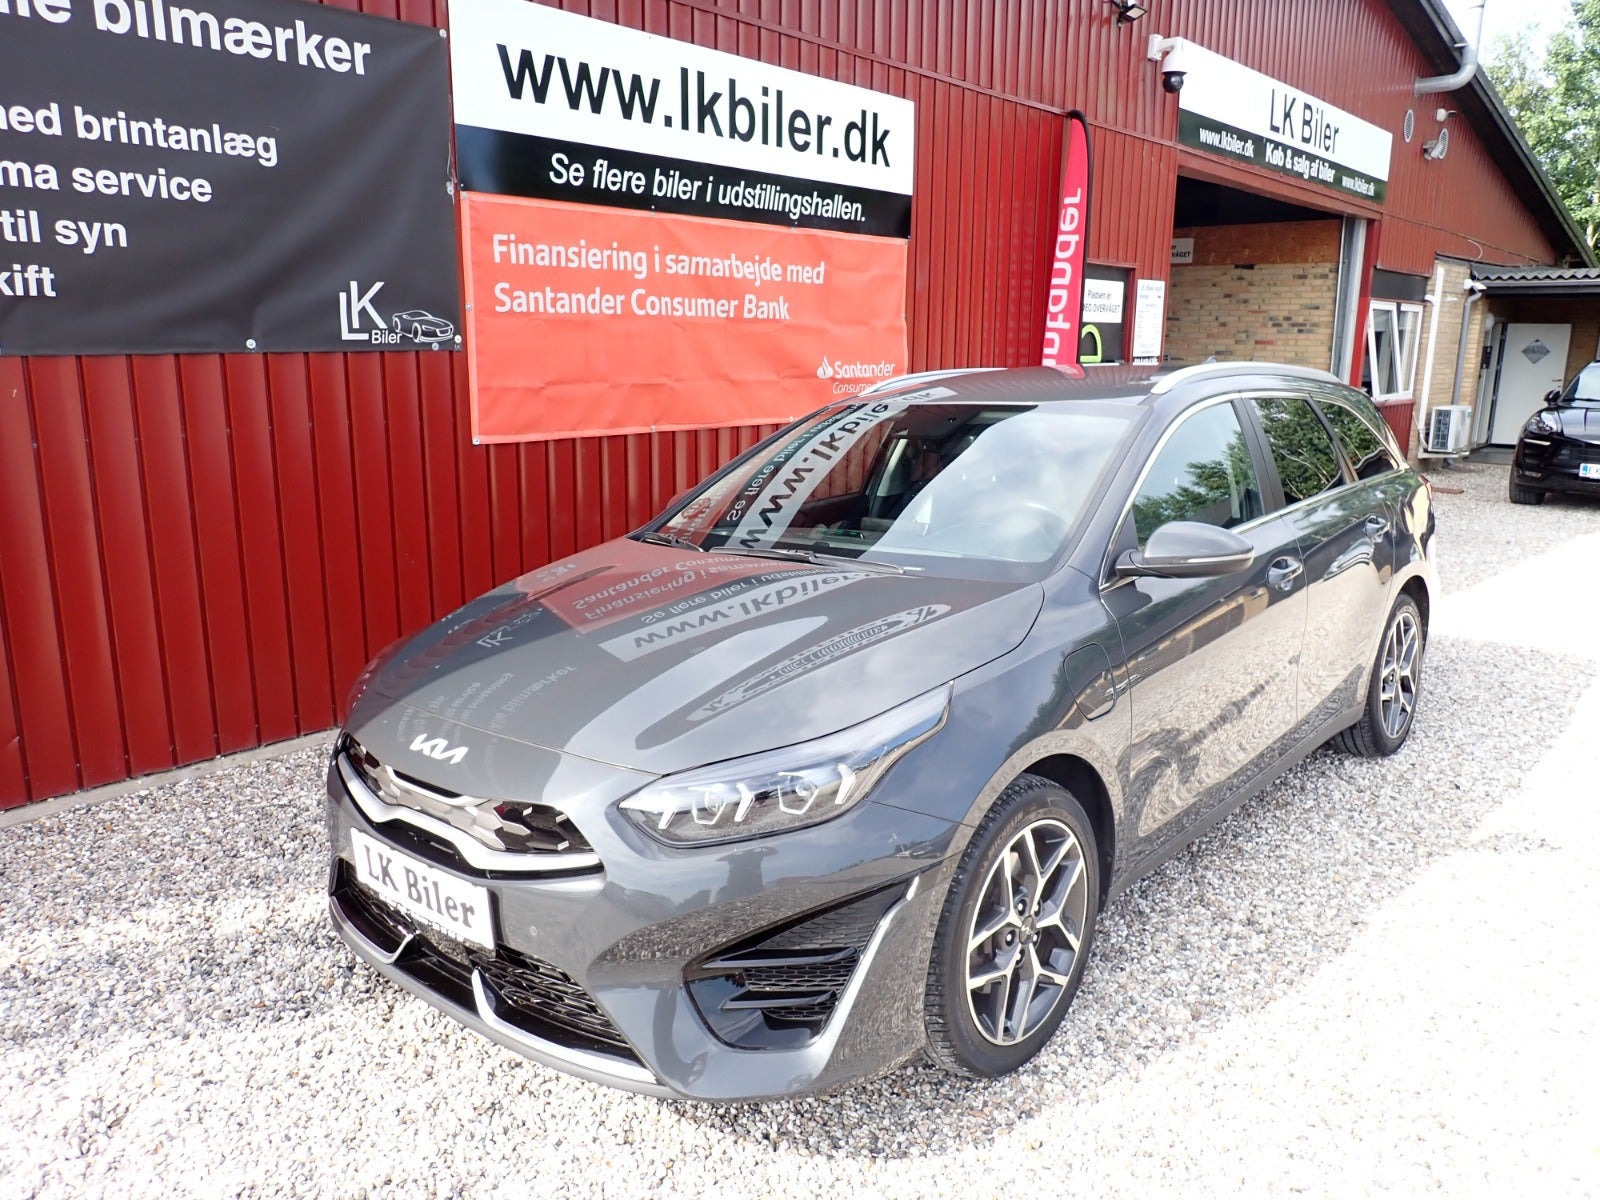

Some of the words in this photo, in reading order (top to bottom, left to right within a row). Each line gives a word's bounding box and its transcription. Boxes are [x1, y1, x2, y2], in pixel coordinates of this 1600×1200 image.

[93, 0, 371, 75] bilmærker
[496, 43, 891, 168] www.lkbiler.dk
[1270, 88, 1296, 138] LK
[1301, 102, 1339, 154] Biler
[74, 105, 278, 167] brintanlæg
[1199, 127, 1254, 158] www.lkbiler.dk
[72, 168, 213, 202] service
[1265, 141, 1284, 167] Køb
[1285, 148, 1292, 169] &
[1293, 154, 1310, 179] salg
[1310, 158, 1319, 177] af
[1319, 160, 1336, 183] biler
[549, 153, 585, 186] Se
[593, 158, 646, 194] flere
[652, 168, 702, 202] biler
[706, 175, 714, 202] i
[718, 180, 866, 222] udstillingshallen.
[1, 210, 41, 243] til
[54, 218, 128, 254] syn
[493, 233, 647, 279] Finansiering
[653, 246, 660, 272] i
[665, 252, 782, 287] samarbejde
[786, 261, 825, 285] med
[339, 281, 388, 340] LK
[494, 282, 625, 315] Santander
[631, 288, 738, 318] Consumer
[743, 293, 790, 320] Bank
[371, 330, 402, 344] Biler
[832, 382, 878, 394] Consum
[834, 360, 895, 379] Santander
[363, 843, 399, 893] LK
[403, 866, 476, 929] Biler
